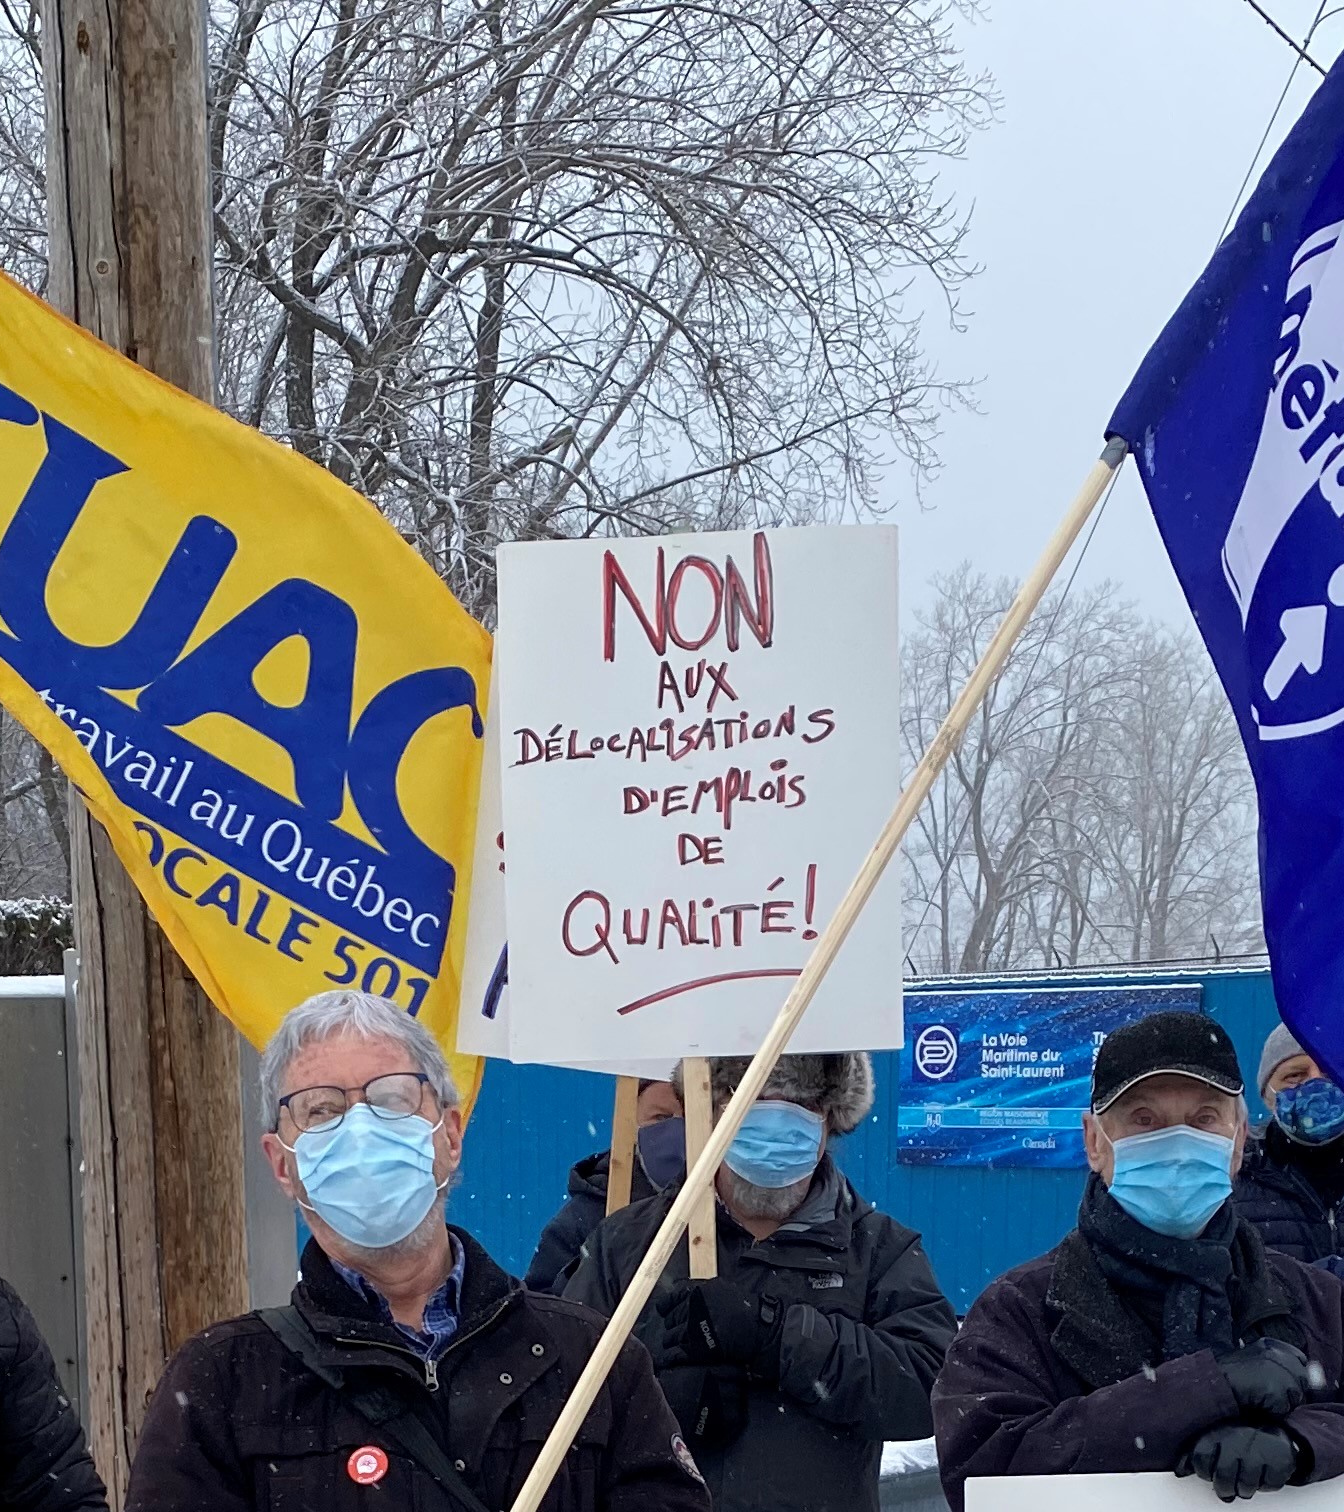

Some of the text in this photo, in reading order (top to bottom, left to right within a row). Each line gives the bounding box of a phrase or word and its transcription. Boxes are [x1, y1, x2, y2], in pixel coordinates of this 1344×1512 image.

[603, 531, 774, 662] NON
[657, 658, 739, 713] AUX
[508, 704, 836, 769] DÉLOCALISATIONS
[189, 788, 256, 847] au
[261, 817, 441, 948] Québec
[678, 833, 726, 865] DE
[323, 937, 431, 1018] 501
[982, 1032, 1028, 1047] La Voie
[982, 1048, 1060, 1063] Maritime du
[981, 1063, 1065, 1078] Saint-Laurent
